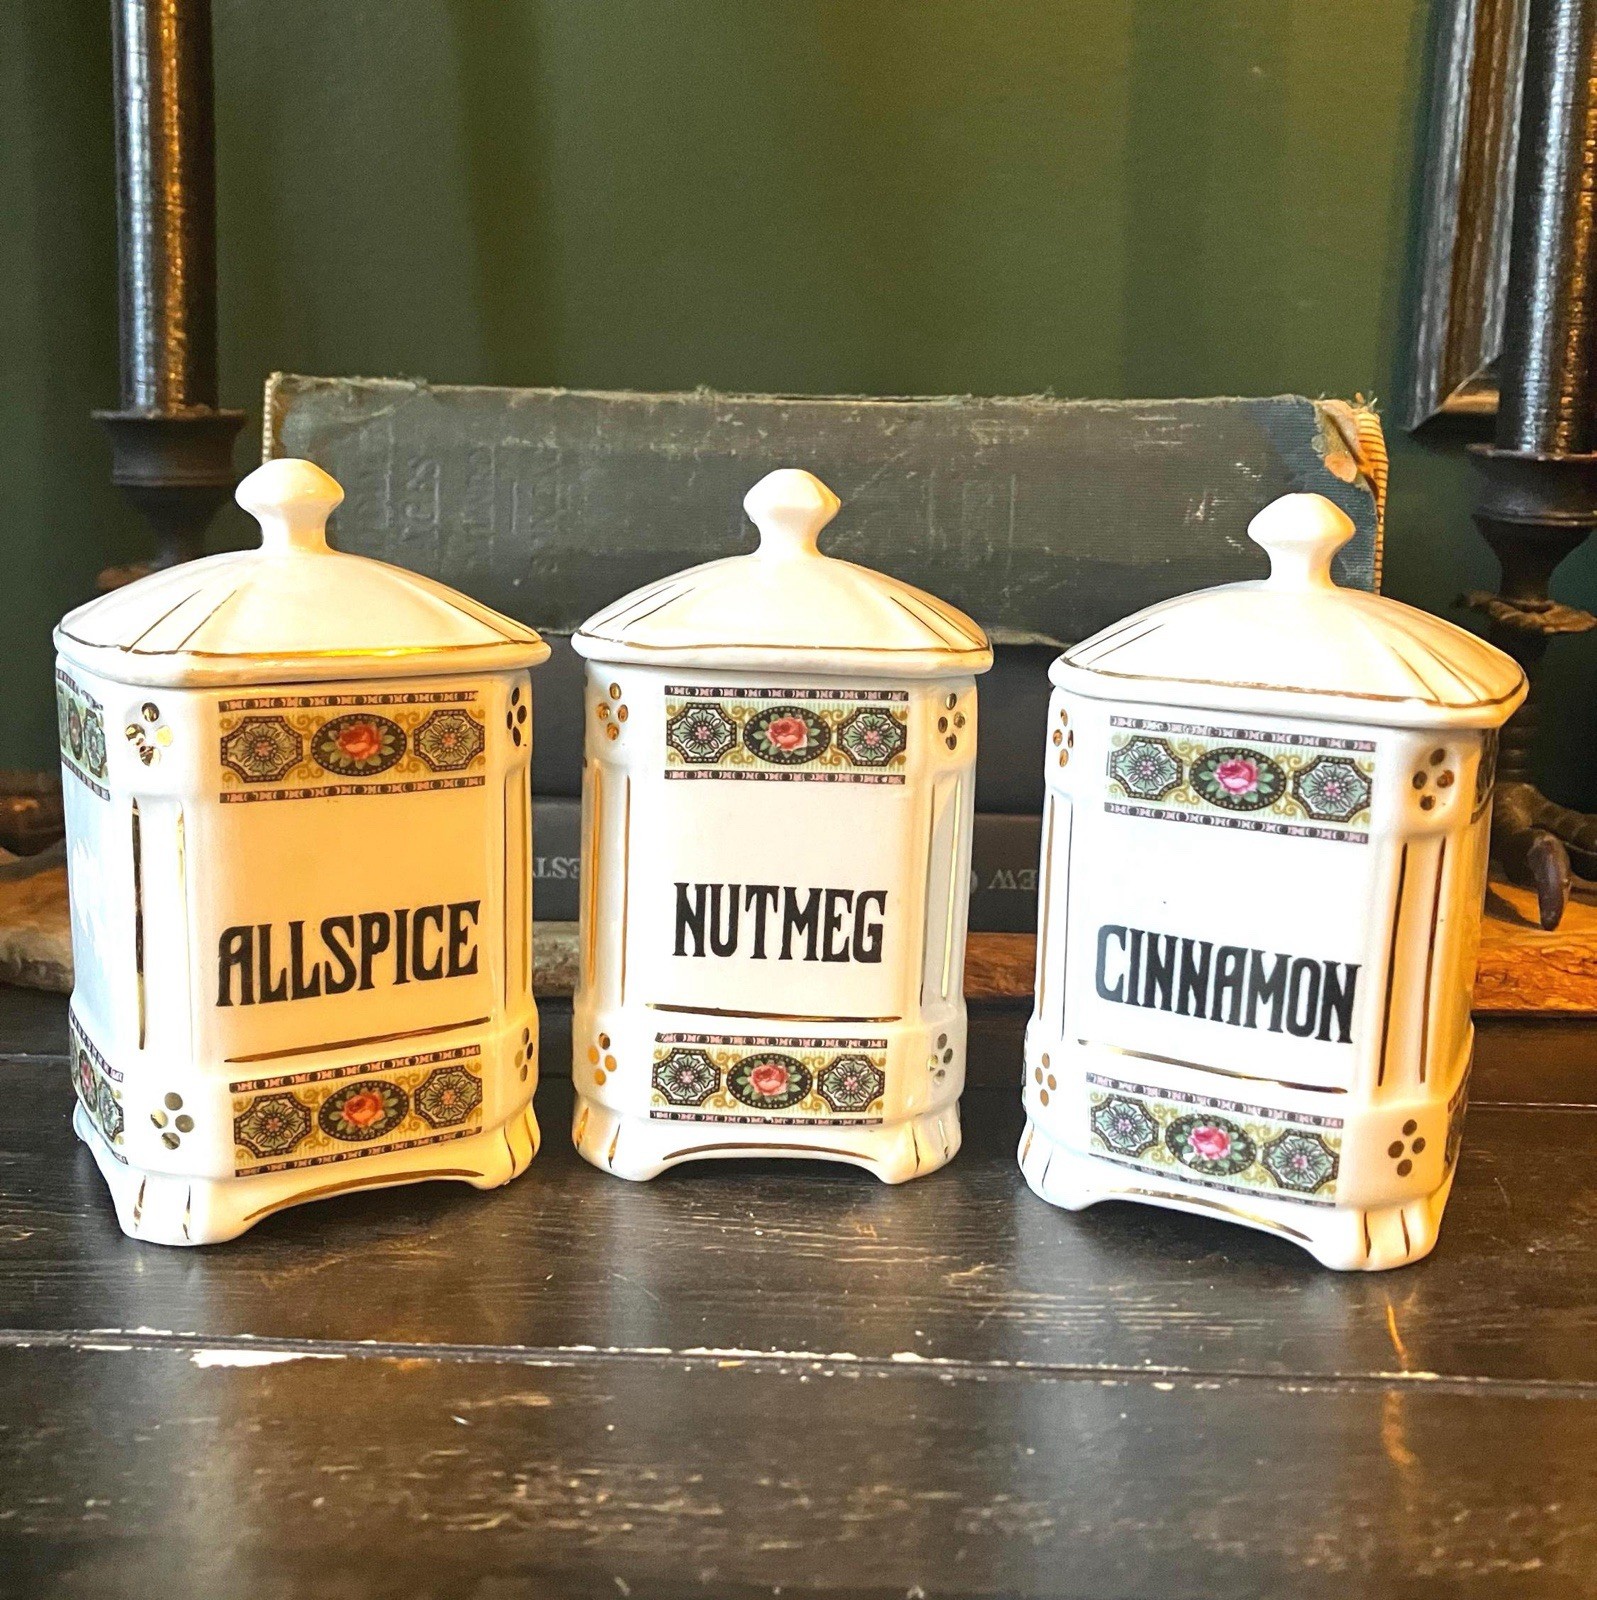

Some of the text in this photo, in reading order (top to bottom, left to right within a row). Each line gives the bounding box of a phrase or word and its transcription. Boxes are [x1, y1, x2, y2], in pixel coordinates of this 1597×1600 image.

[533, 856, 579, 879] EST
[216, 899, 481, 1007] ALLSPICE
[672, 882, 888, 964] NUTMEG
[1096, 924, 1362, 1044] CINNAMON
